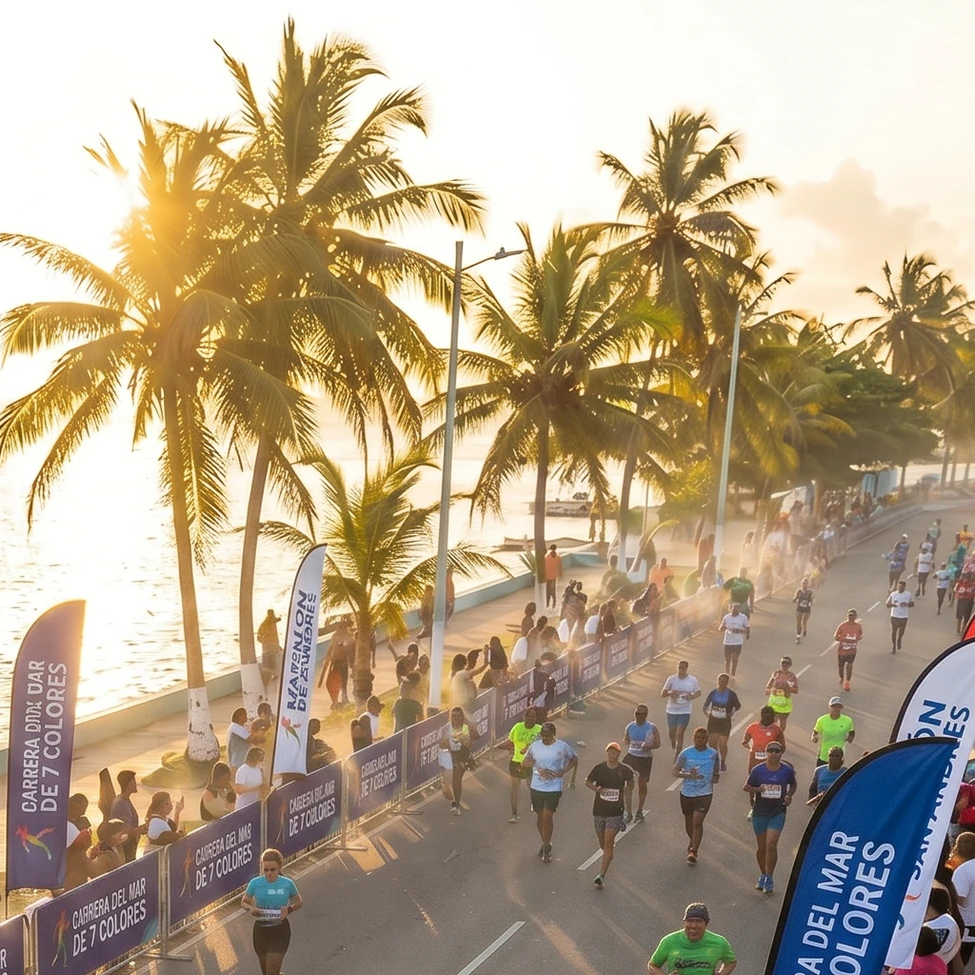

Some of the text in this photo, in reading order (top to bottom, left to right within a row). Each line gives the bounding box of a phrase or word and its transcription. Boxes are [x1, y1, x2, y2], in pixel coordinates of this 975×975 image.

[40, 662, 68, 812] DE 7 COLORES
[21, 737, 41, 813] CARRERA
[195, 842, 253, 890] DE 7 COLORES
[817, 830, 860, 894] MAR
[72, 899, 146, 957] DE 7 COLORES
[111, 887, 128, 911] DEL
[802, 902, 840, 949] DEL
